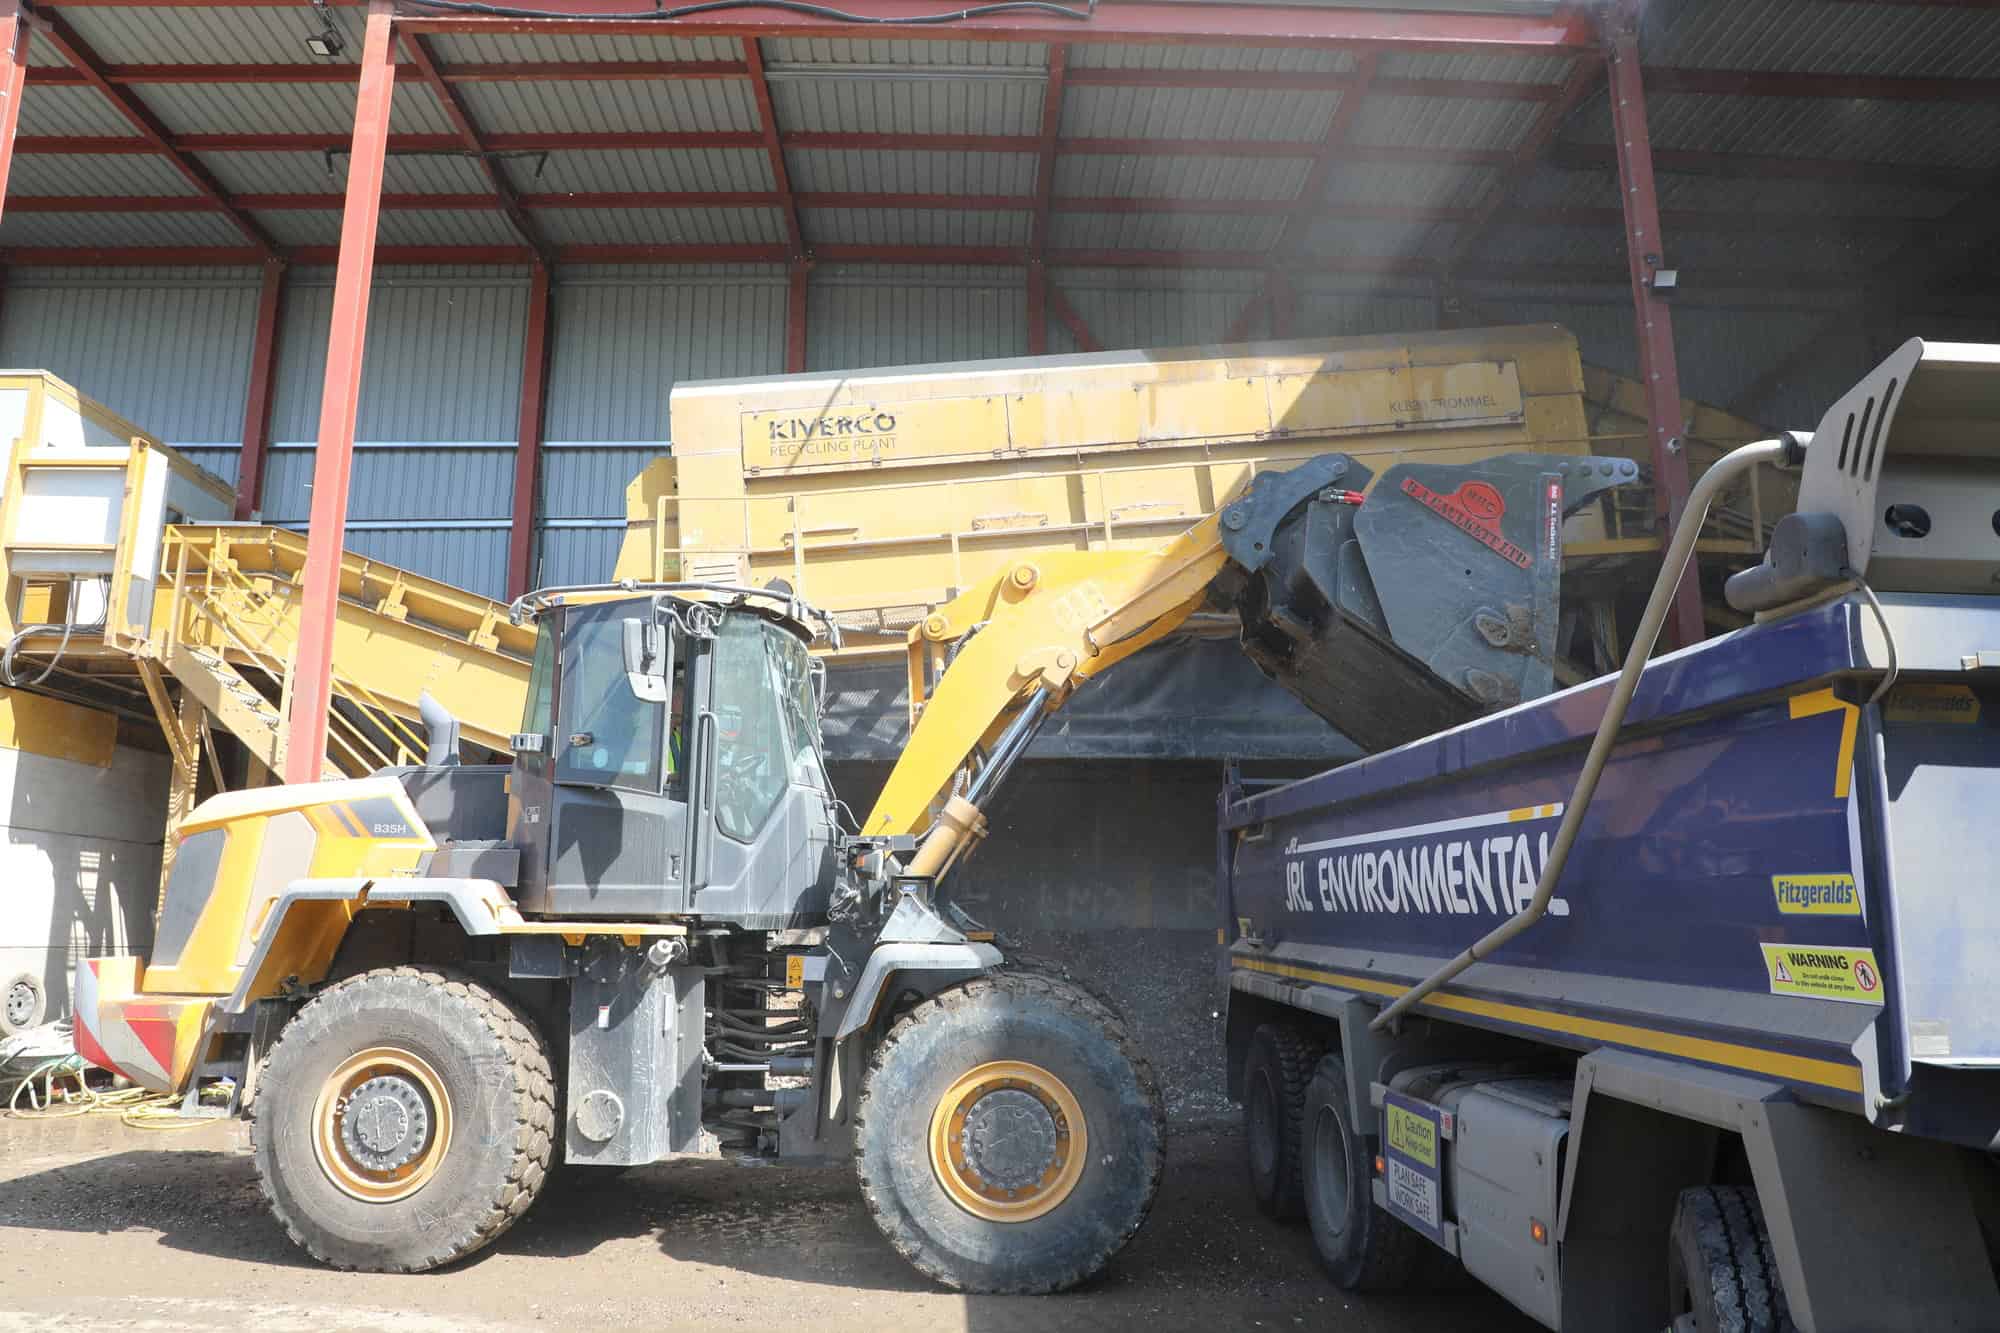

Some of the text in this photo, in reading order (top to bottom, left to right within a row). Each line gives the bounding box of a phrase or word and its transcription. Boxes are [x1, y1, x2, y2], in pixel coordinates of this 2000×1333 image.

[769, 413, 896, 440] KIVERCO
[770, 438, 896, 457] RECYCLING PLANT
[1285, 832, 1569, 916] JRL ENVIRONMENTAL
[1778, 880, 1854, 908] Fitzgeralds
[1787, 952, 1849, 970] WARNING
[1405, 1115, 1433, 1142] Caution
[1393, 1163, 1427, 1195] PLAN SAFE
[1394, 1187, 1432, 1222] WORK SAFE
